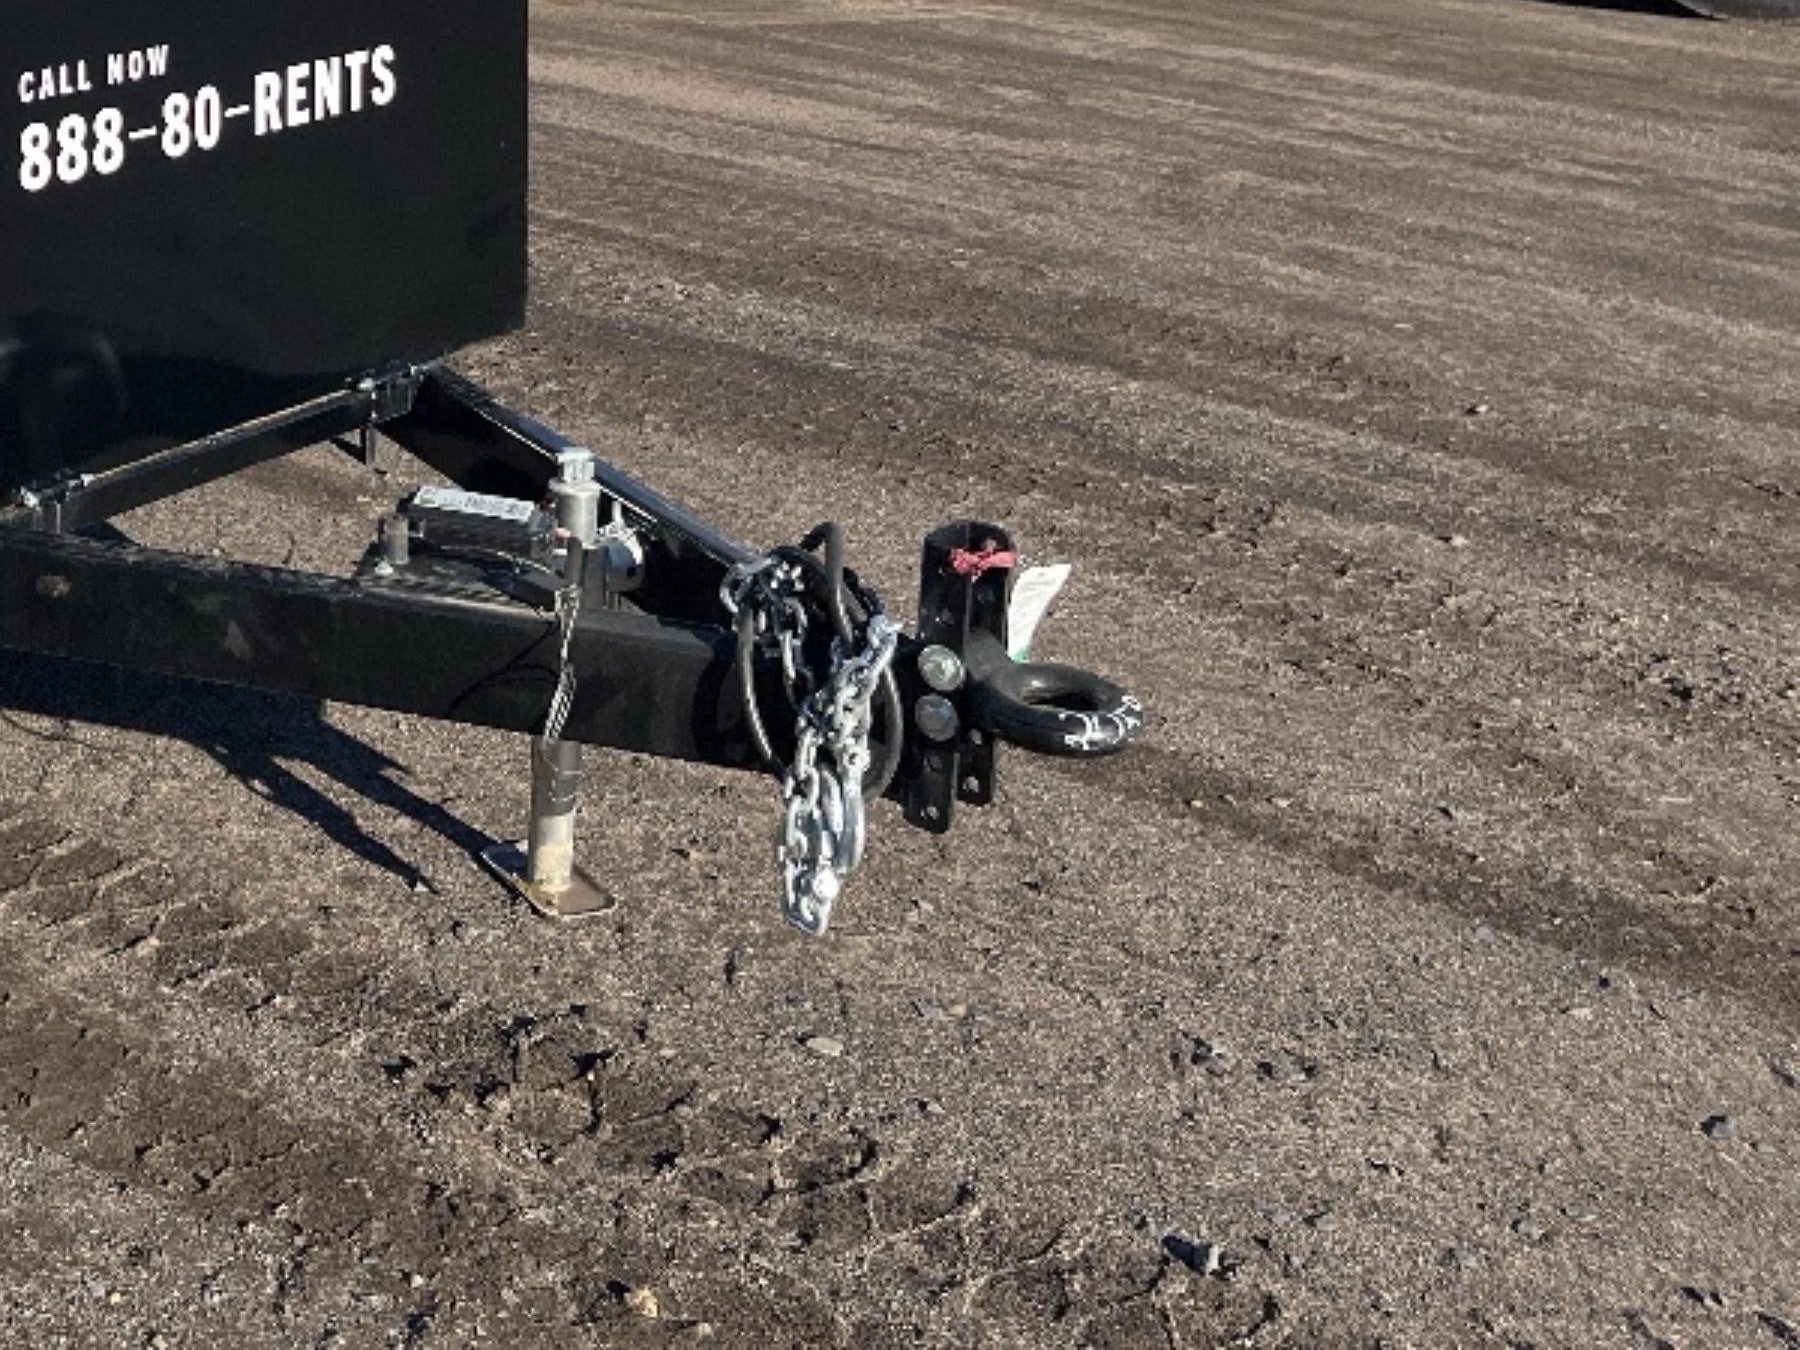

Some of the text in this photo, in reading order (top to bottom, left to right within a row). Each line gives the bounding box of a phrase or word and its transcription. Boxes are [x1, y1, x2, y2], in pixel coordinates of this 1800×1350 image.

[18, 44, 170, 103] CALL NOW
[18, 44, 398, 192] 888-80-RENTS
